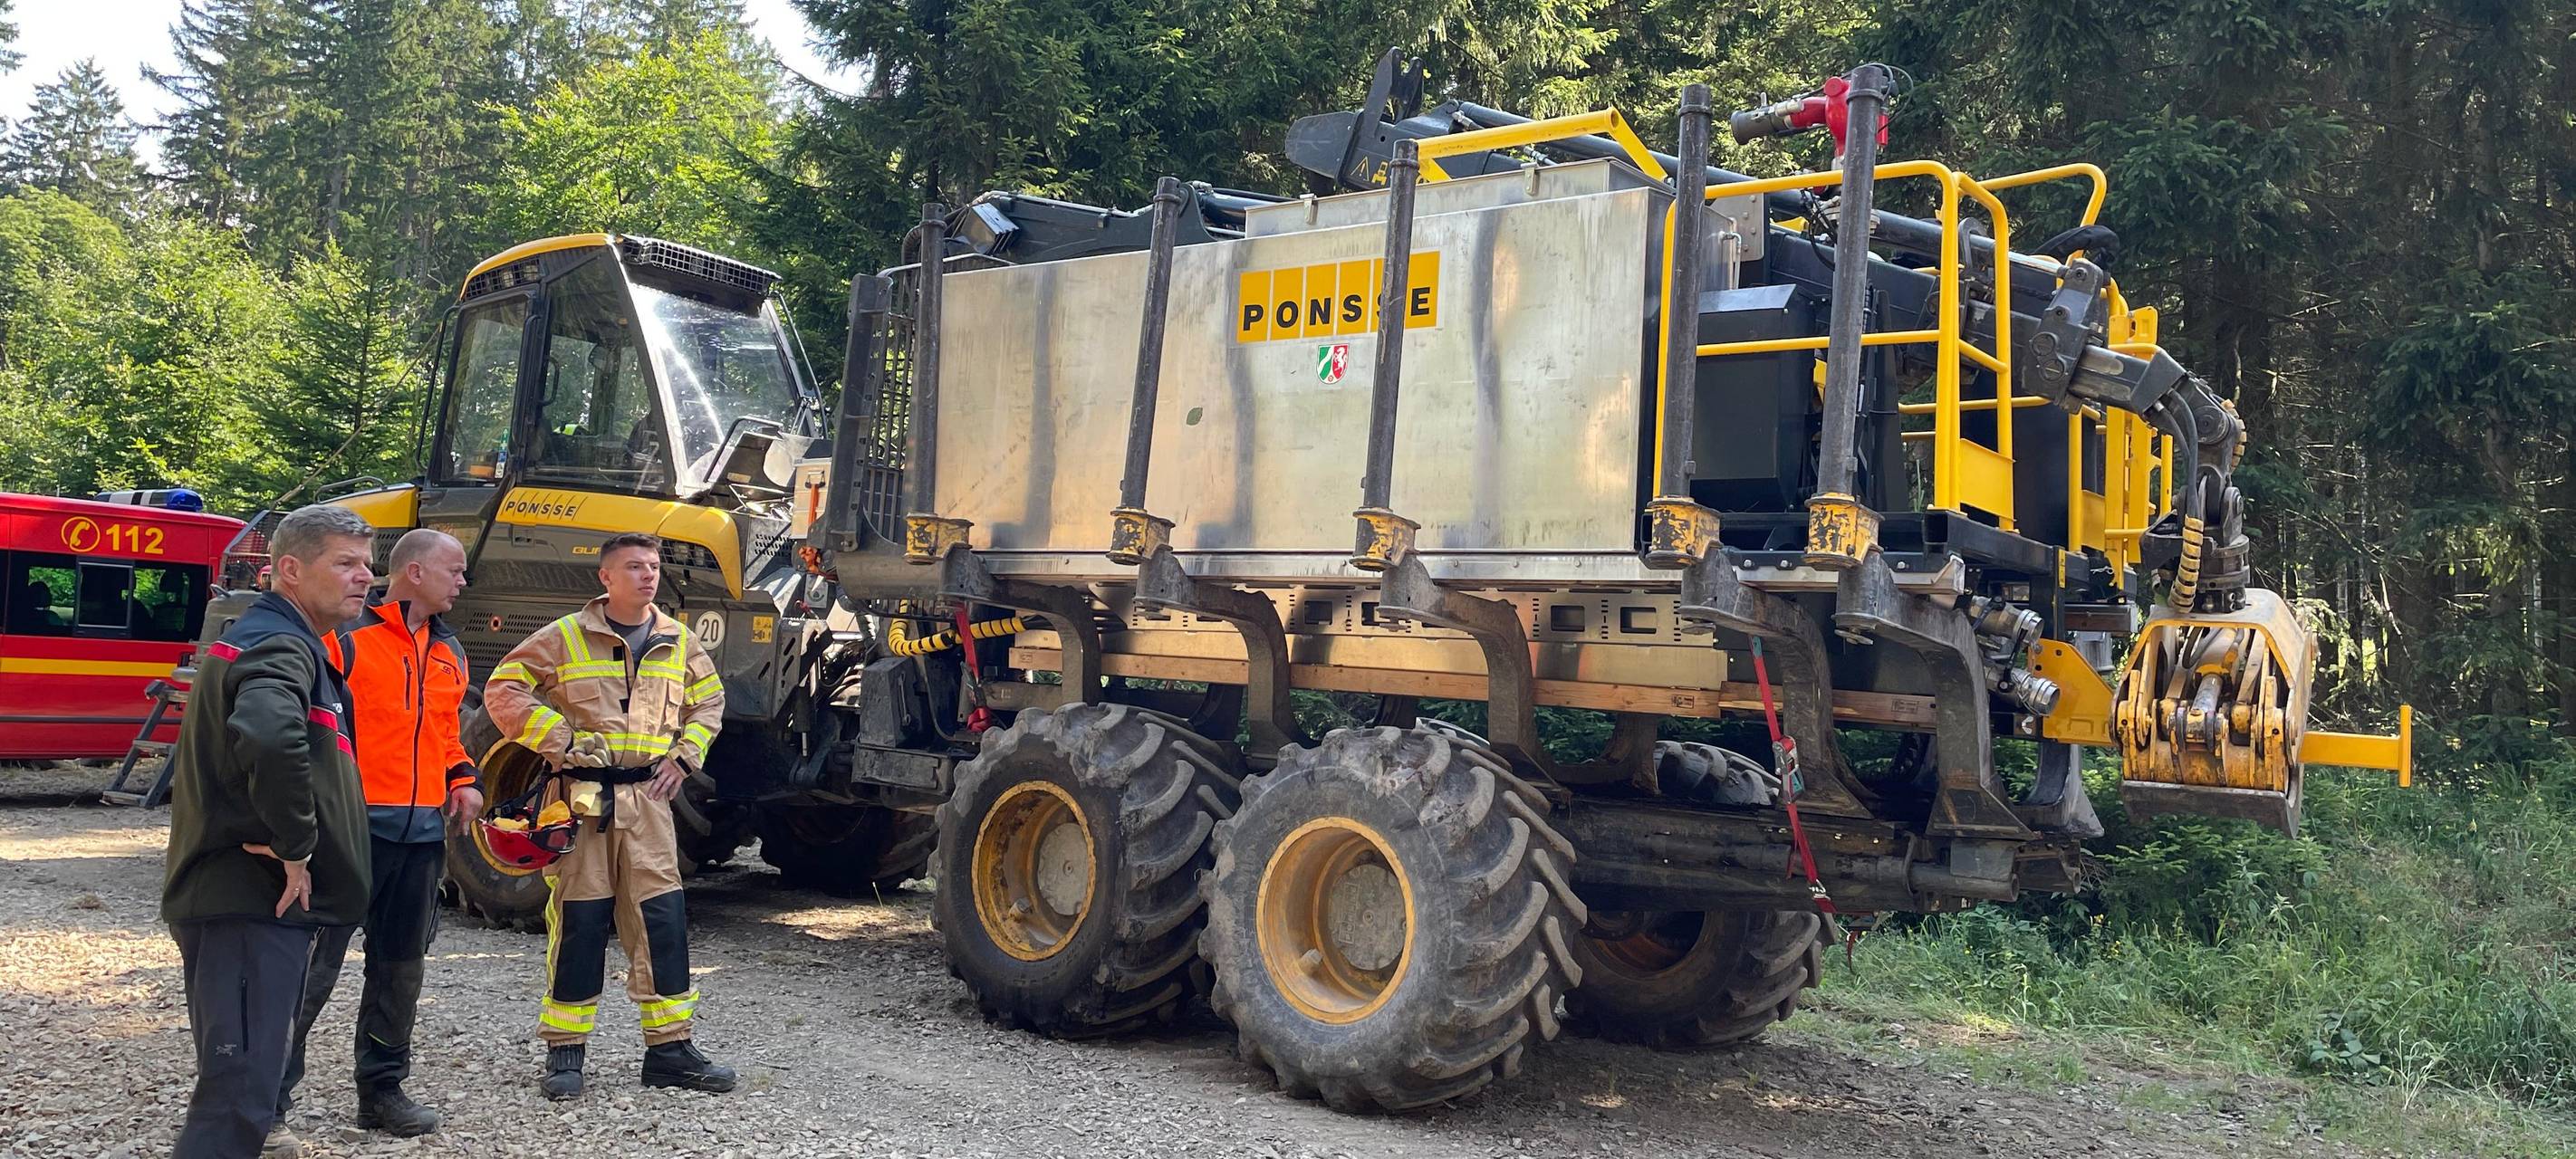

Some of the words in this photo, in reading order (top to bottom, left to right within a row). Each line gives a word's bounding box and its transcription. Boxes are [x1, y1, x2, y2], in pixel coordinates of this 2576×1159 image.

[1243, 286, 1431, 331] PONSE
[505, 501, 577, 516] PONSSE
[106, 523, 164, 554] 112
[700, 618, 719, 643] 20
